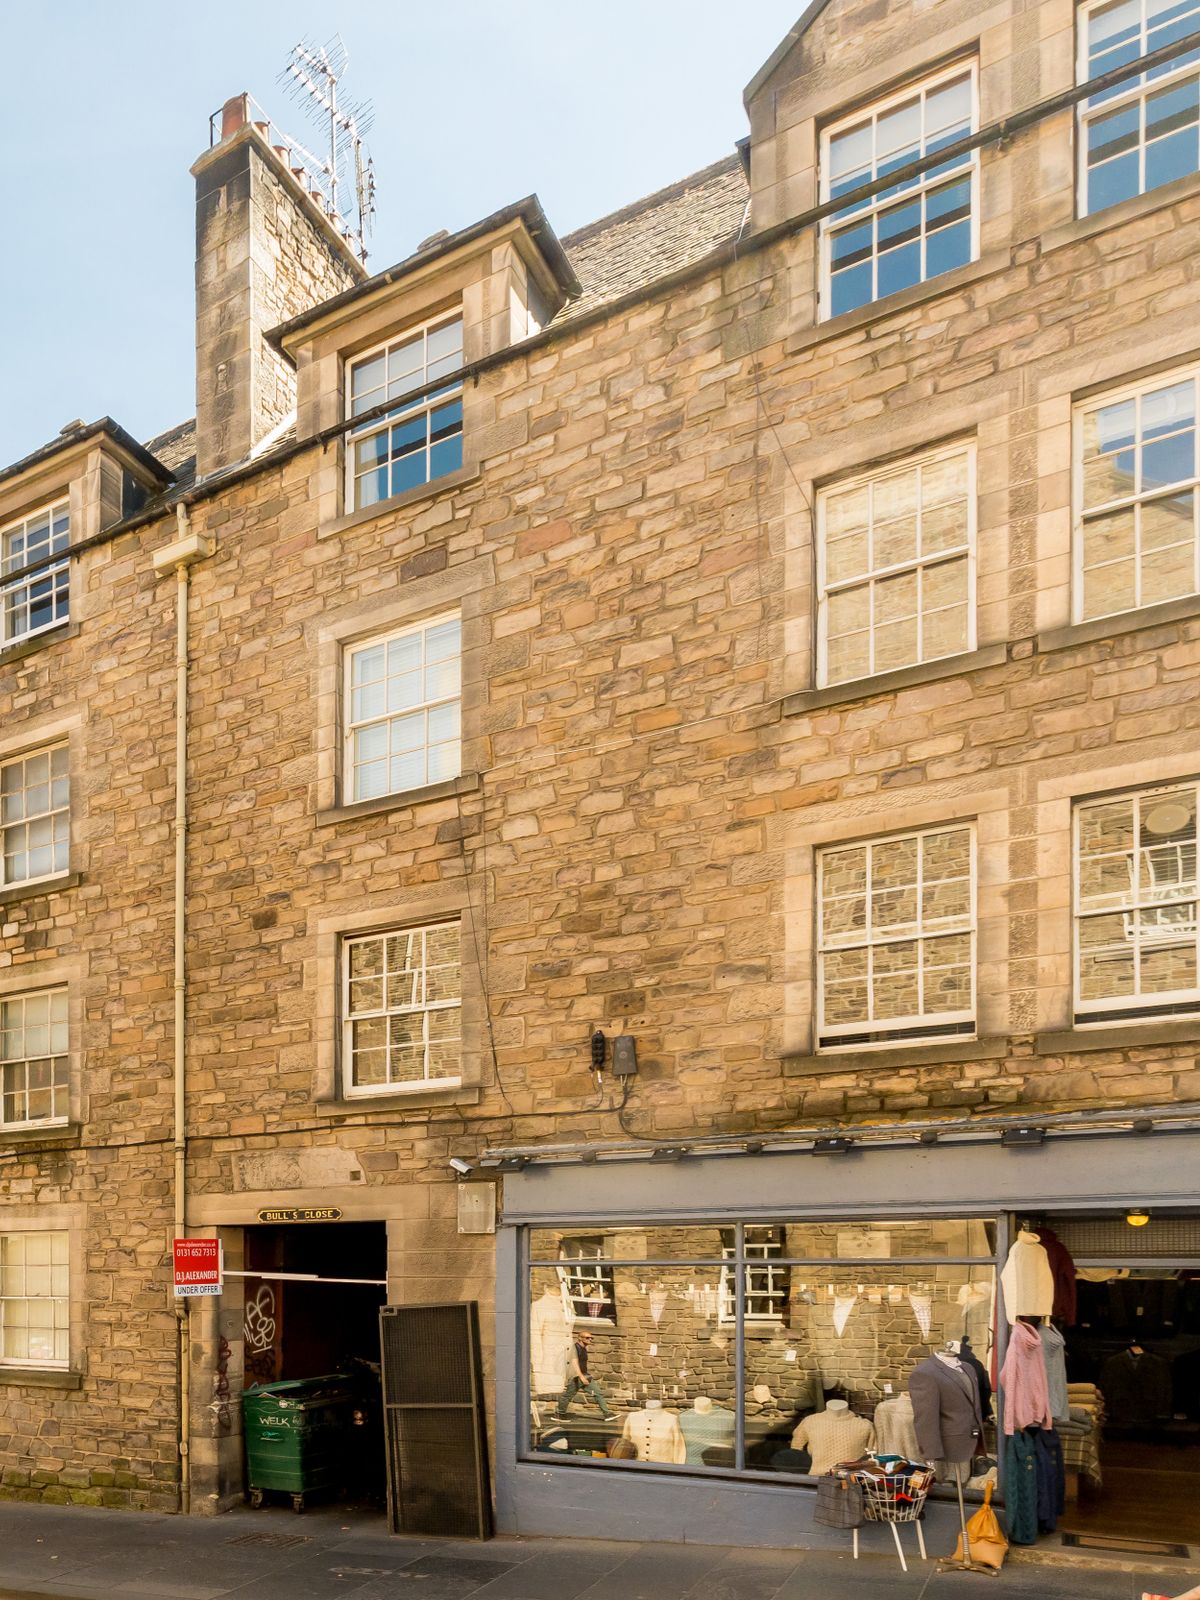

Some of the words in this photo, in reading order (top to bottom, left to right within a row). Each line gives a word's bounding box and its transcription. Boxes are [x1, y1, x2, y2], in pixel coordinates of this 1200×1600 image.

[266, 1211, 298, 1220] BULL'S
[304, 1210, 334, 1219] CLOSE
[176, 1249, 191, 1257] 0131
[191, 1248, 202, 1257] 652
[202, 1248, 217, 1257] 7313
[177, 1286, 199, 1295] UNDER
[199, 1285, 219, 1294] OFFER
